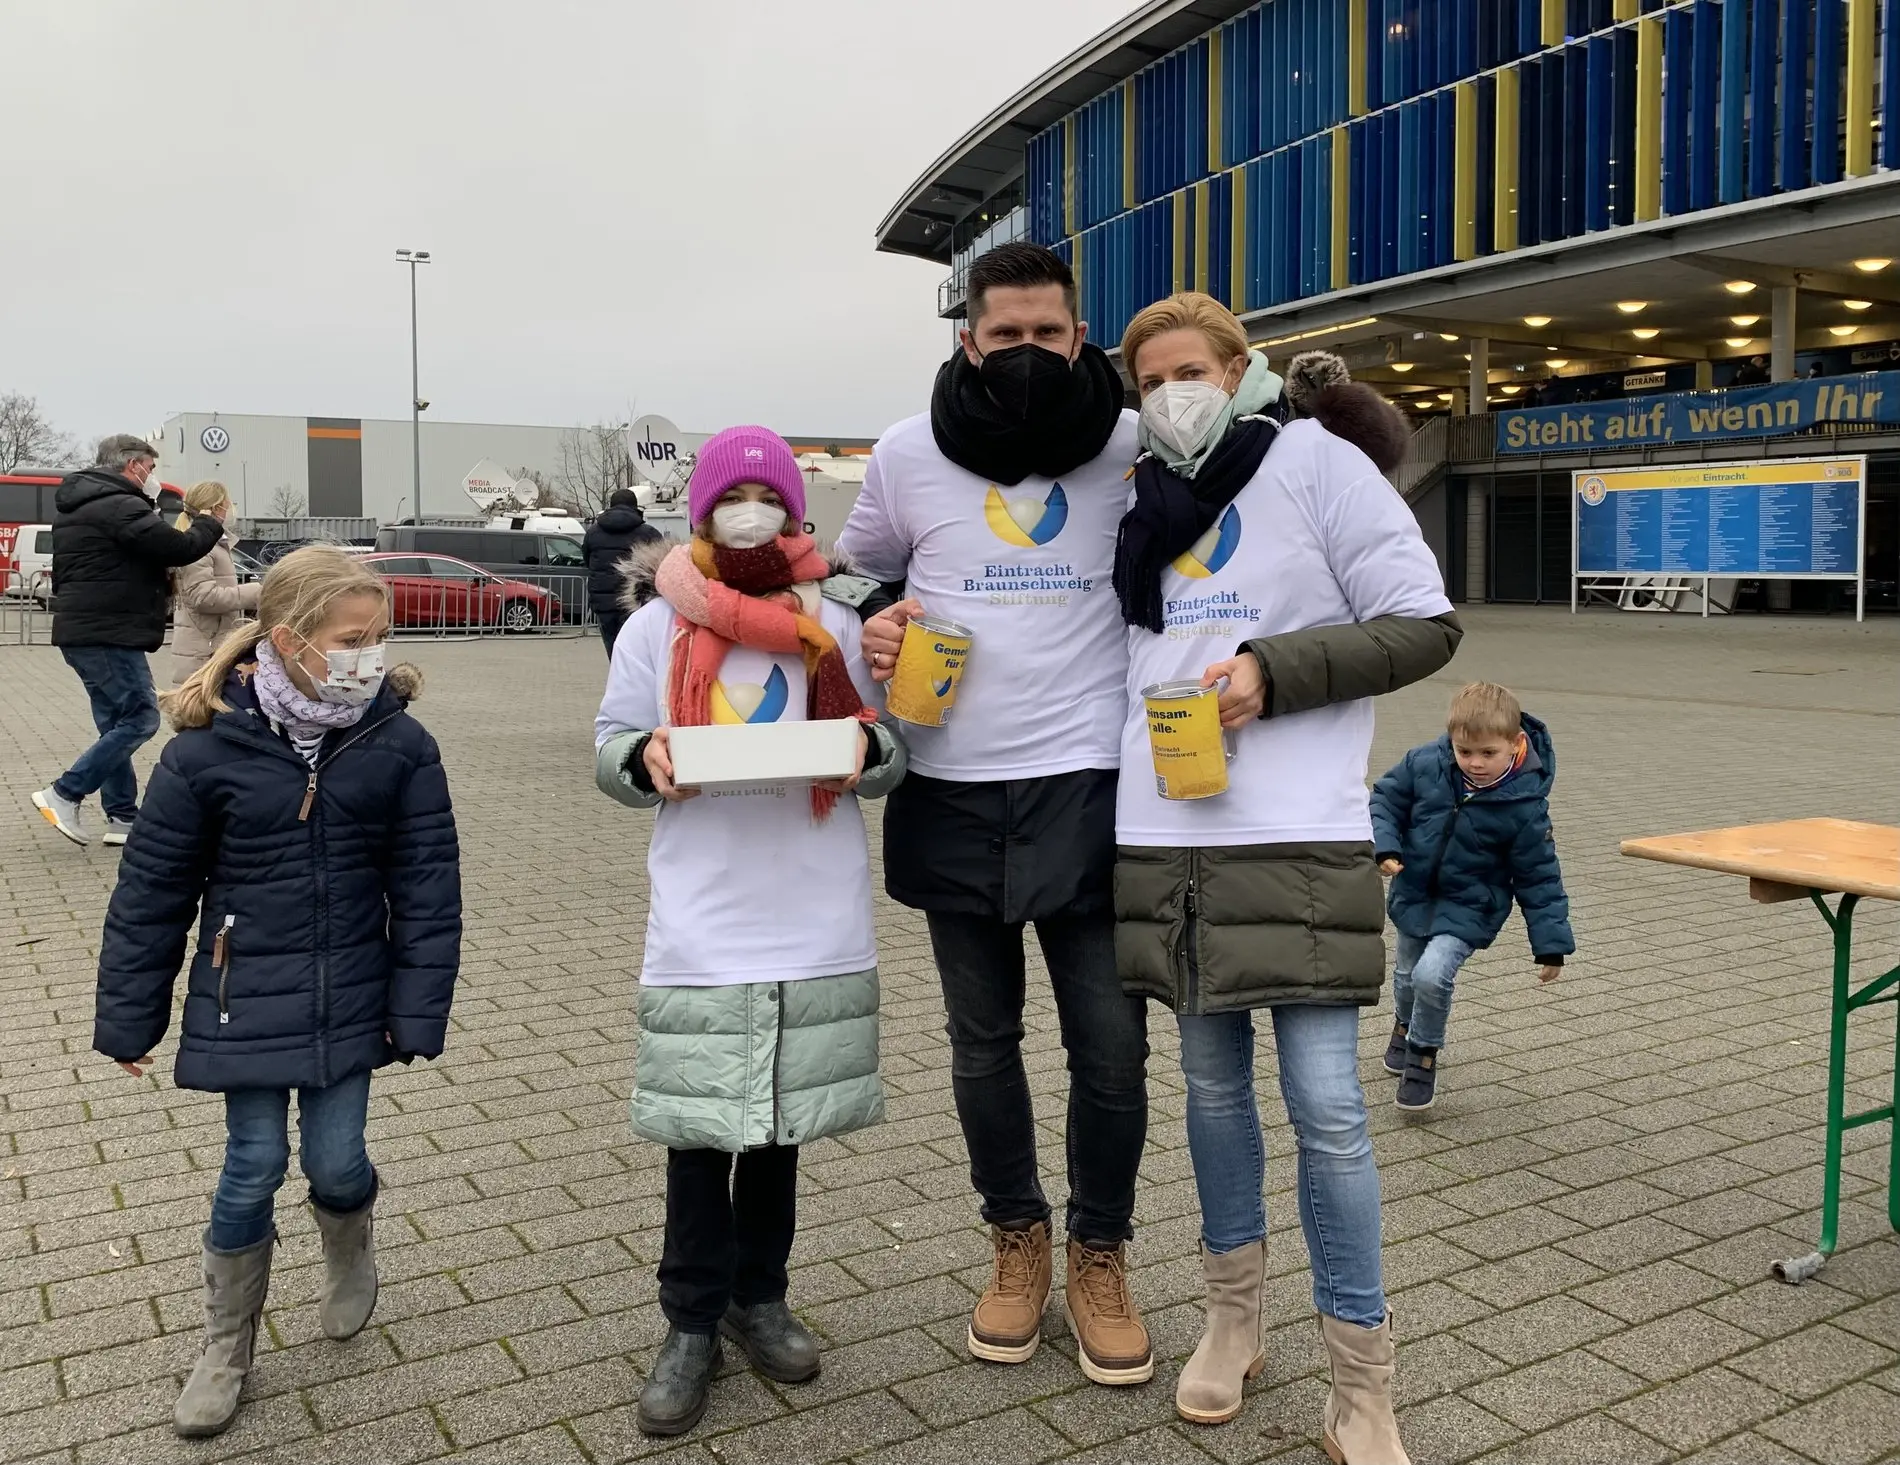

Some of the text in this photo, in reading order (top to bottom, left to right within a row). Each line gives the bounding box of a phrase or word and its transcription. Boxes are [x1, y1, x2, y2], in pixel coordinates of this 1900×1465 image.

[1507, 384, 1884, 448] Steht auf, wenn Ihr
[636, 441, 677, 461] NDR
[745, 448, 763, 457] Lee
[468, 479, 491, 487] MEDIA
[469, 486, 512, 494] BROADCAST
[984, 564, 1073, 578] Eintracht
[963, 577, 1093, 592] Braunschweig
[990, 593, 1069, 607] Stiftung
[945, 658, 960, 668] für
[1152, 722, 1177, 734] alle.
